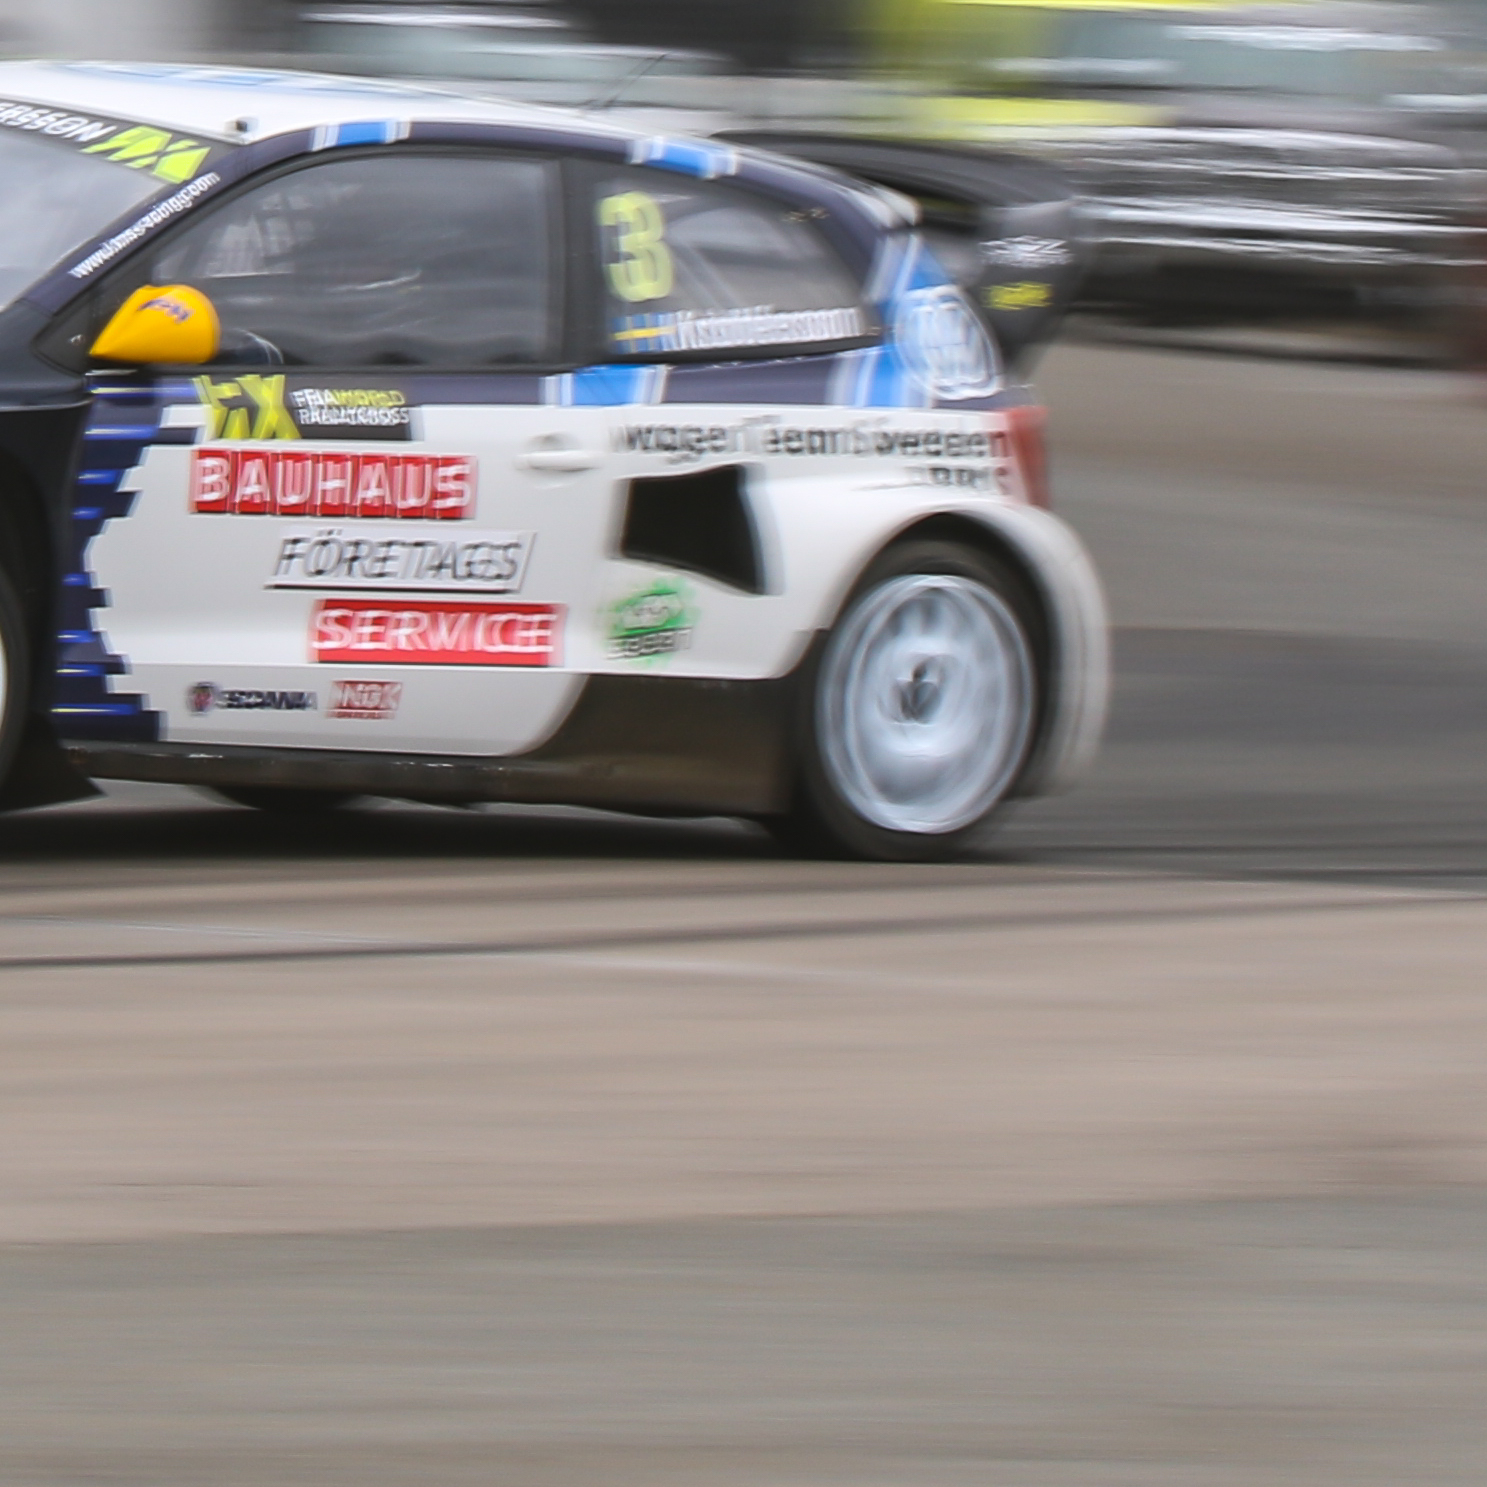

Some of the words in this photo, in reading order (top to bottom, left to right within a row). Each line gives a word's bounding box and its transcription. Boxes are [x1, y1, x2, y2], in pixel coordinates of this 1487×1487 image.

[599, 191, 676, 302] 3
[194, 456, 473, 510] BAUHAUS
[272, 529, 522, 582] FÖRETAGS
[312, 608, 558, 654] SERVICE
